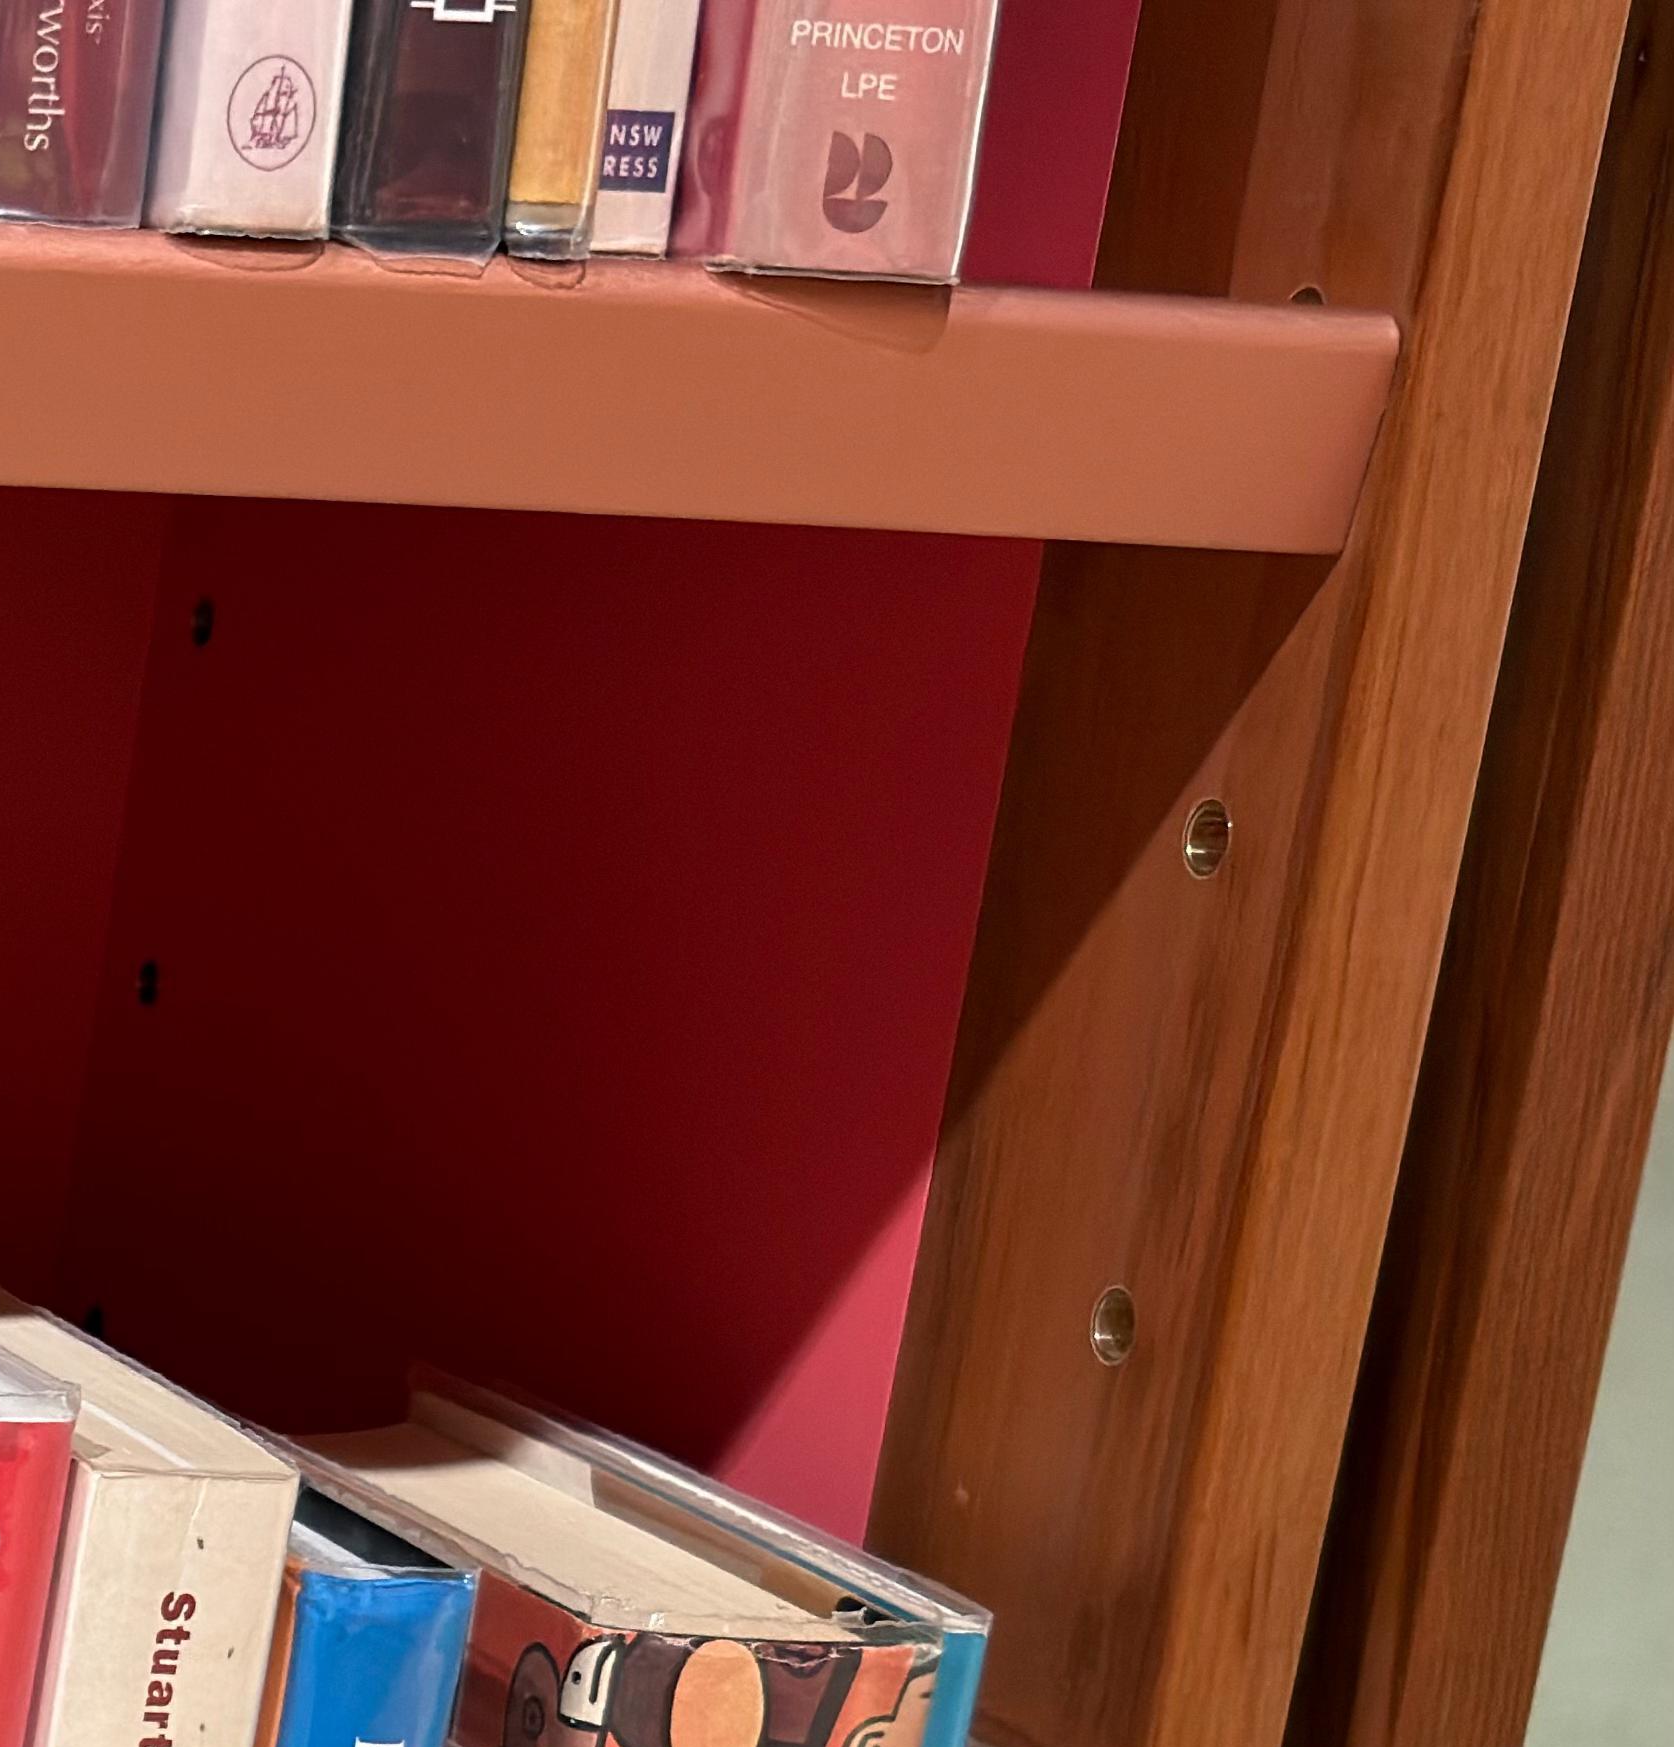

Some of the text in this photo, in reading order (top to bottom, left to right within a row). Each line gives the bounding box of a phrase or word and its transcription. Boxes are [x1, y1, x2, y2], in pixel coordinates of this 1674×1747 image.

[791, 20, 964, 56] PRINCETON
[841, 72, 898, 101] LPE
[609, 124, 663, 146] NSW
